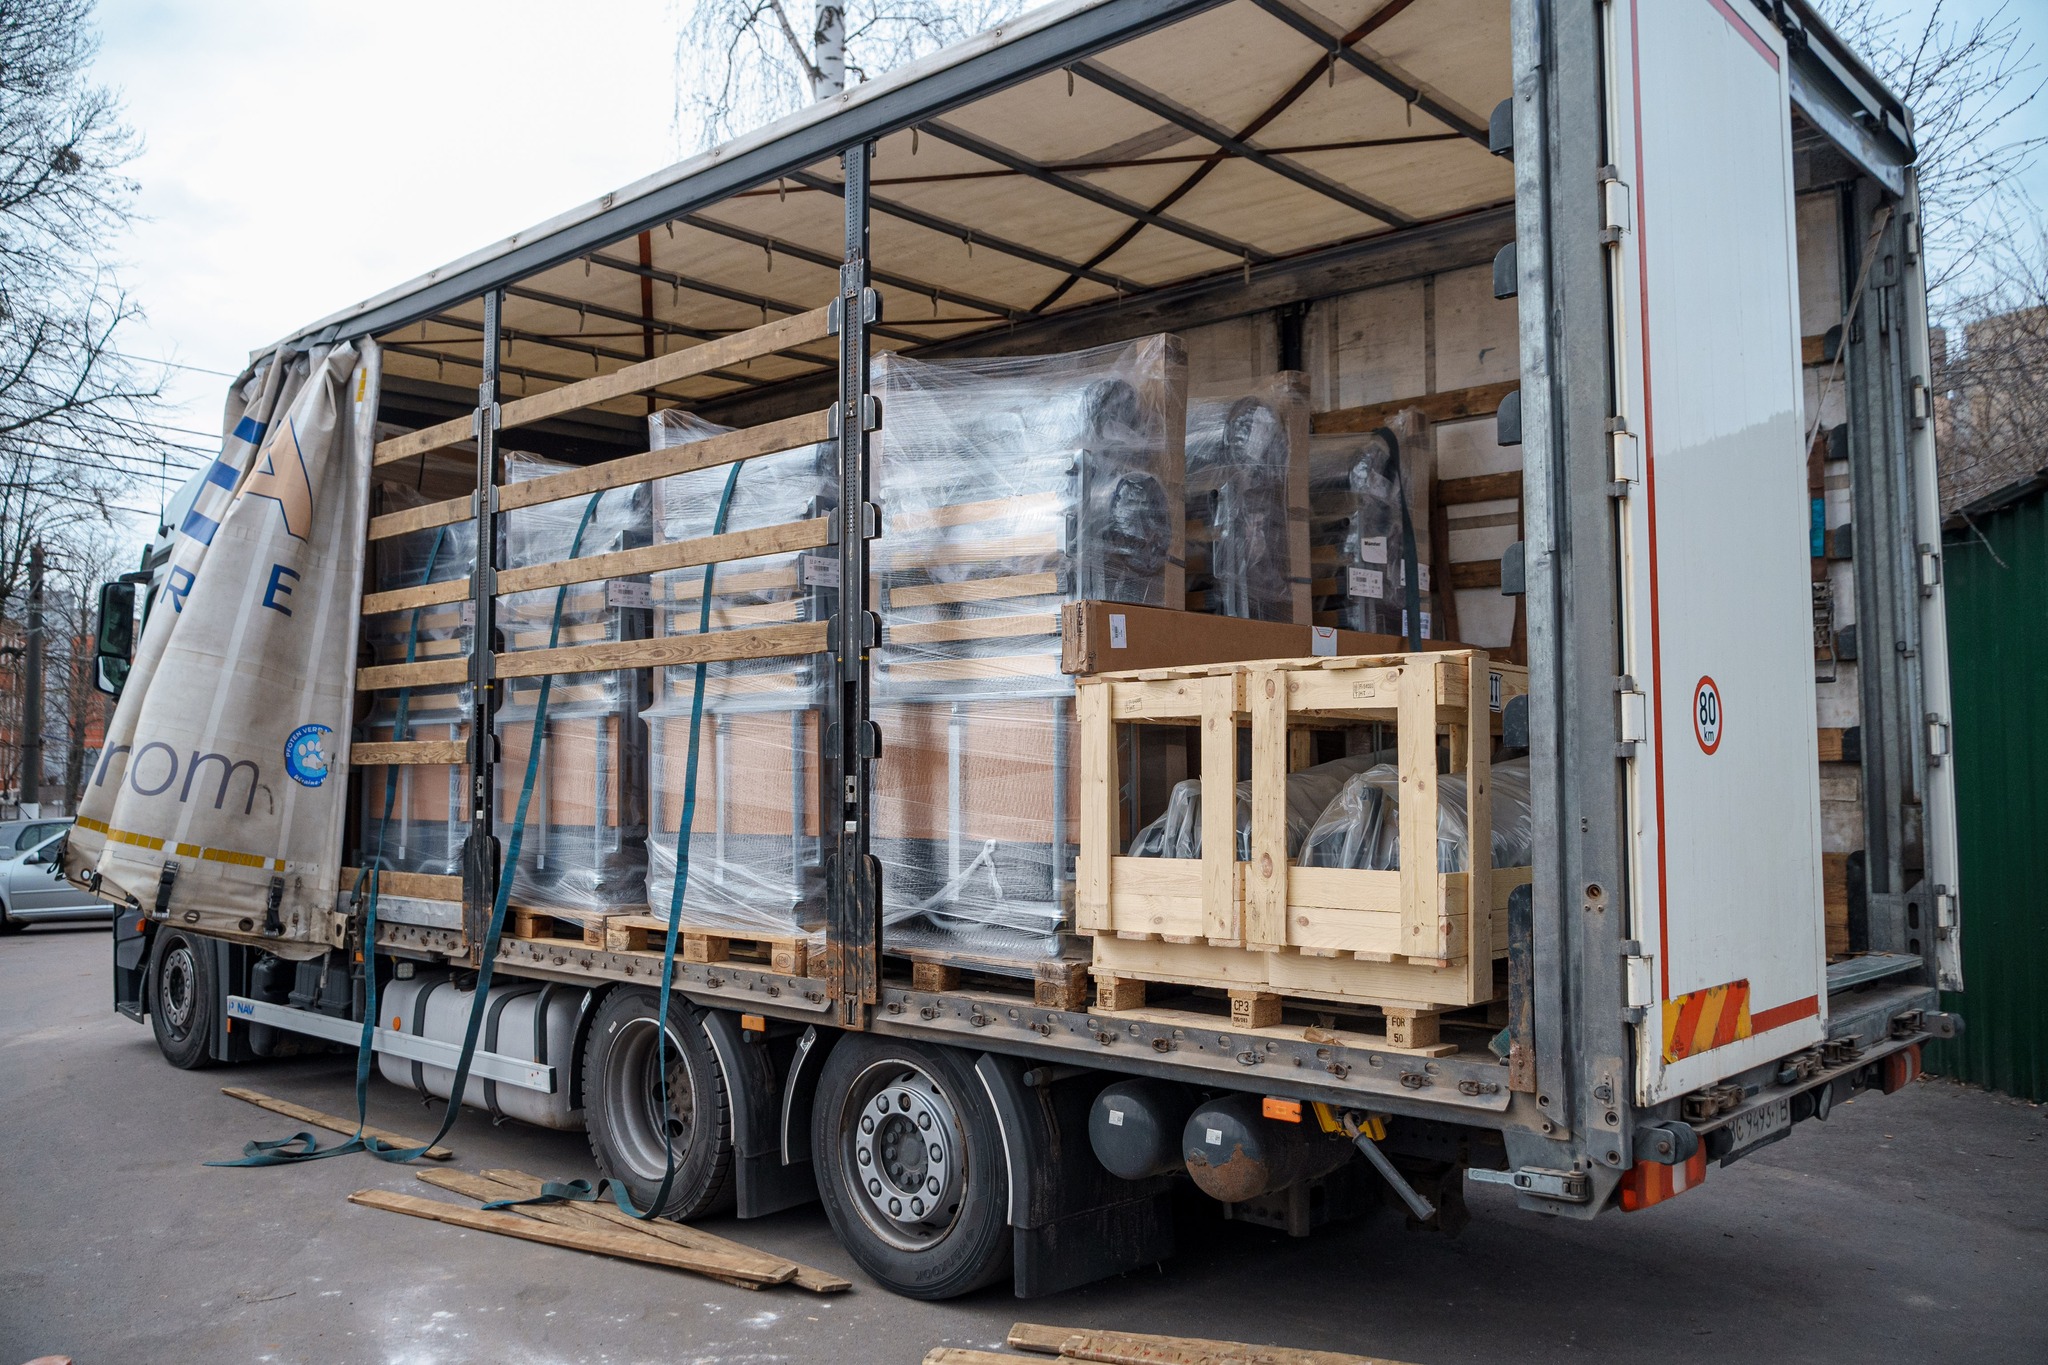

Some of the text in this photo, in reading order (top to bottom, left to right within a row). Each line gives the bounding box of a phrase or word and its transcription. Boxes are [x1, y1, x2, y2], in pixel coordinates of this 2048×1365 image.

[1699, 691, 1716, 726] 80
[1703, 727, 1715, 741] km
[285, 731, 302, 757] PFOTEN
[237, 1002, 254, 1015] NAV
[1391, 1017, 1405, 1027] FOR
[1394, 1033, 1403, 1042] 50
